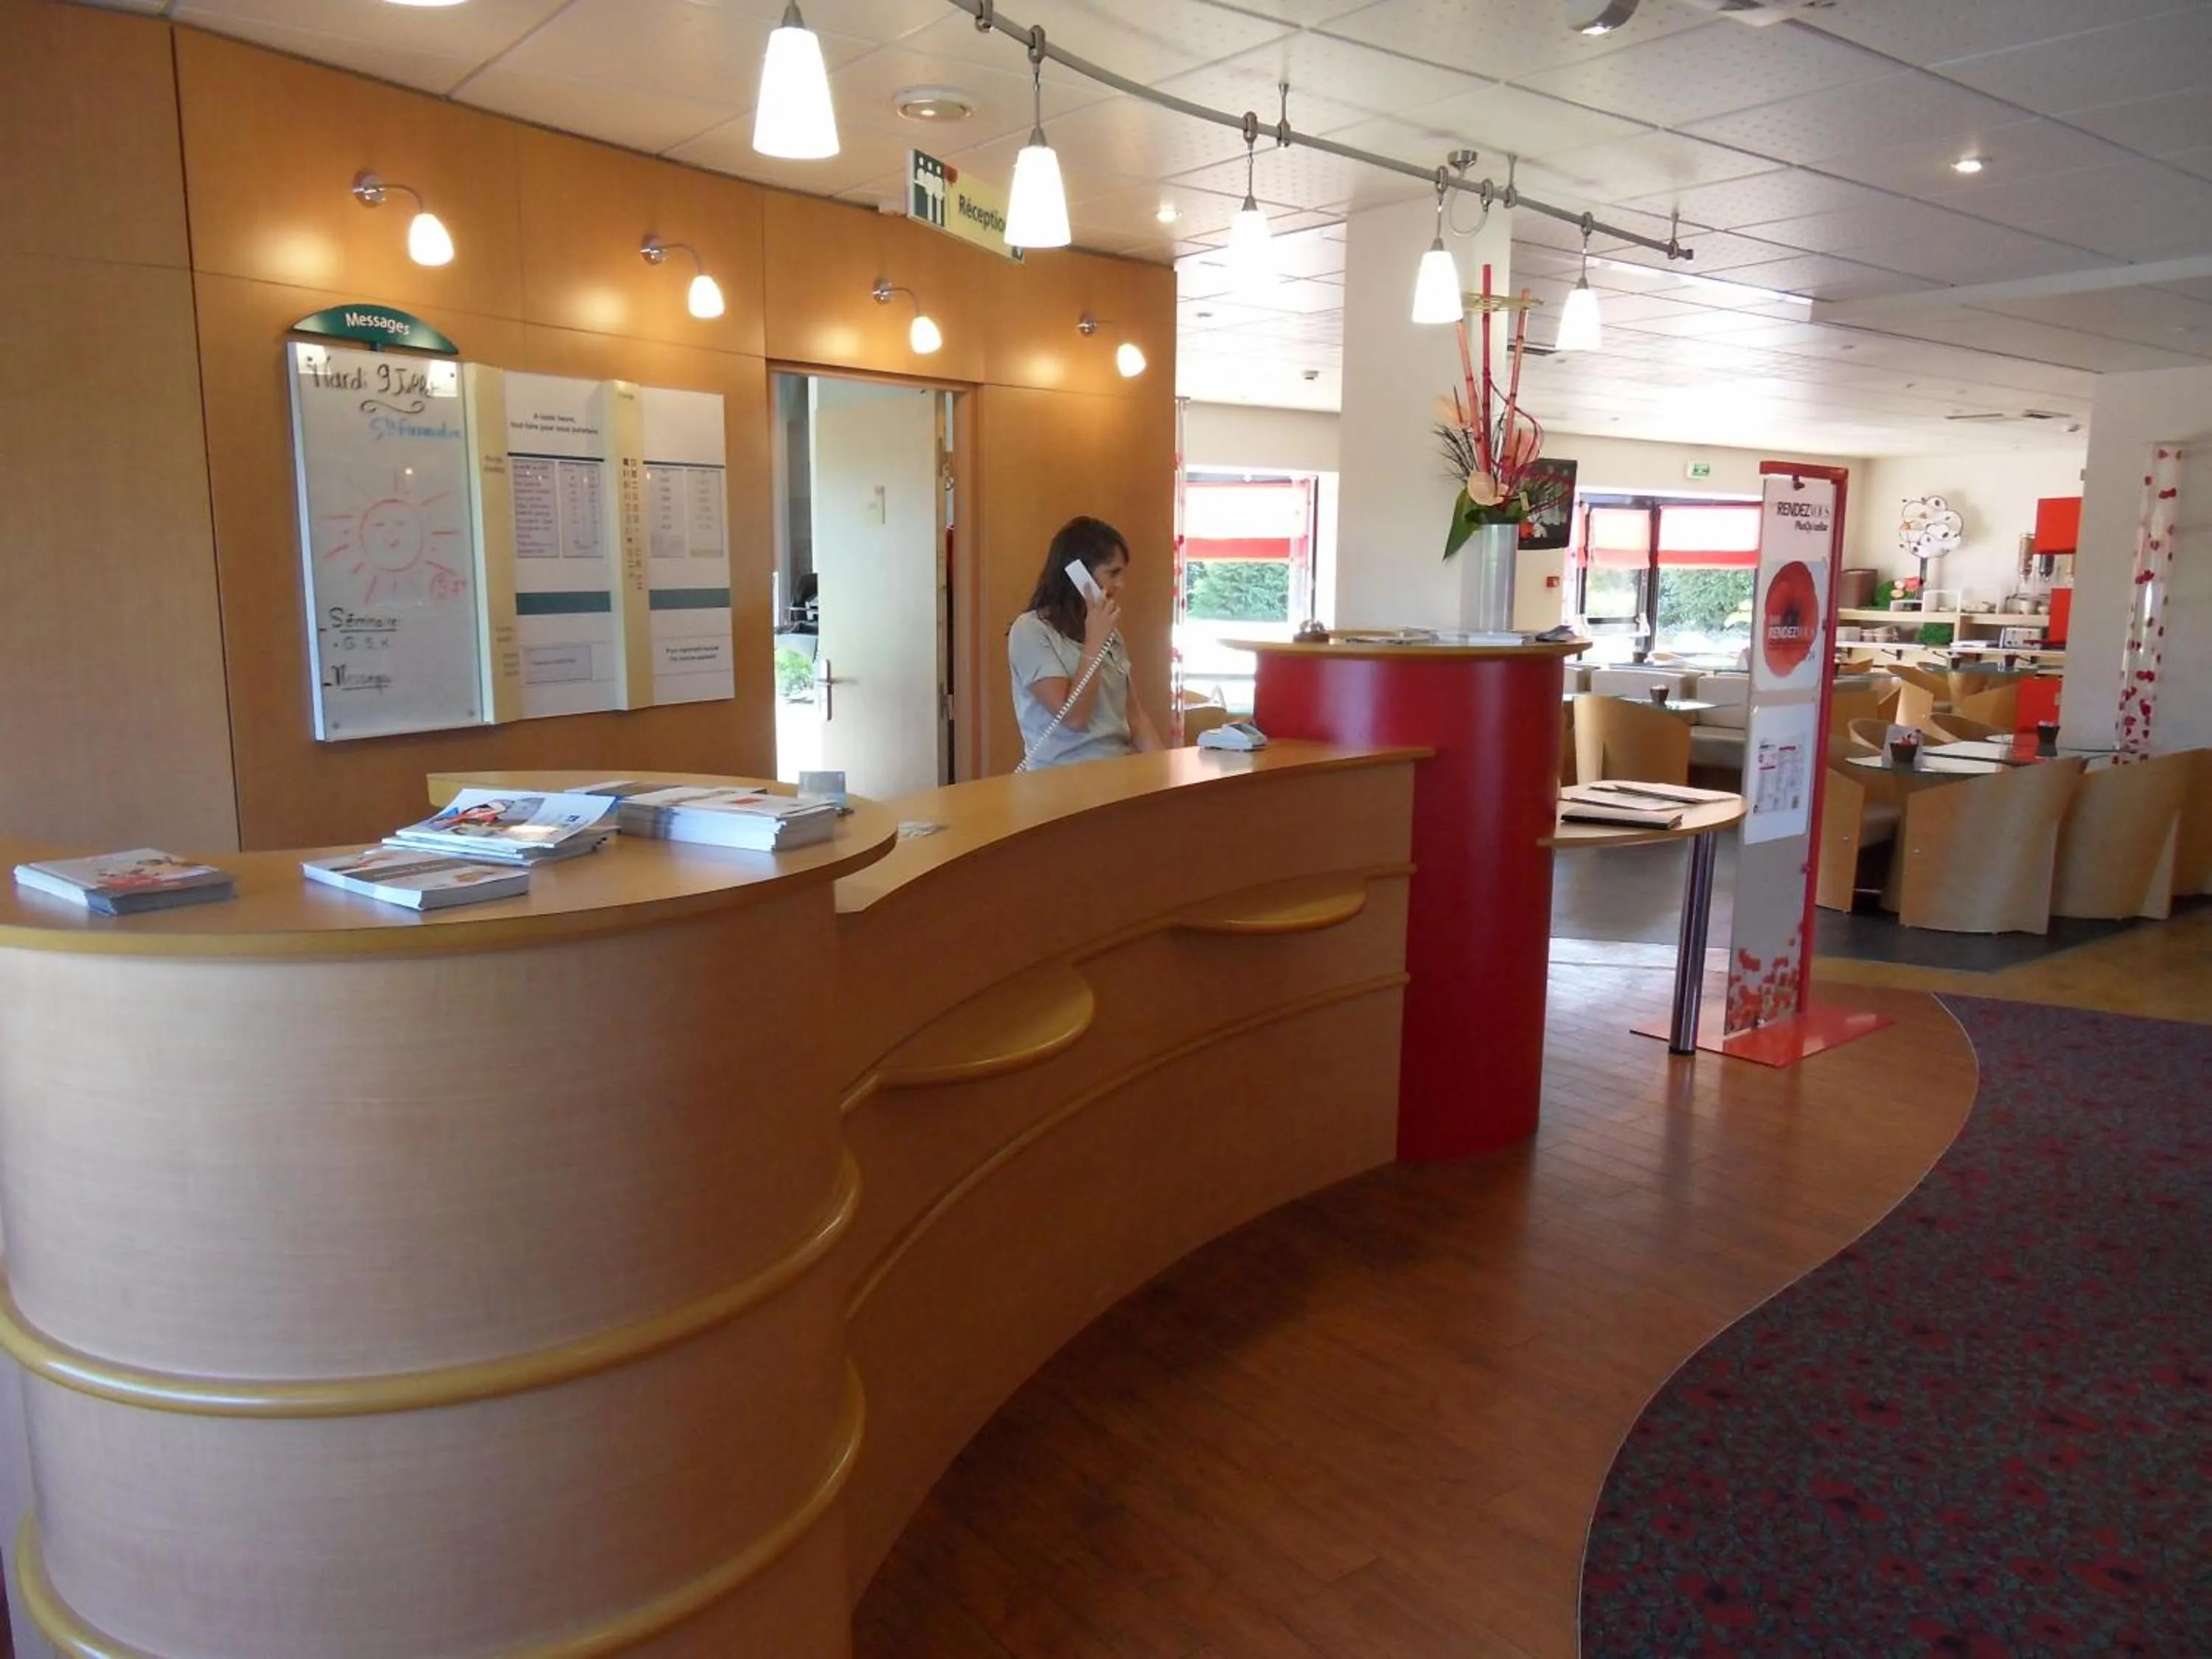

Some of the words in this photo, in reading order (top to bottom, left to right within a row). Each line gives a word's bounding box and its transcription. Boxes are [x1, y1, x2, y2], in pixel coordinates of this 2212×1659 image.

[959, 193, 1006, 232] Réceptio
[345, 313, 410, 335] Messages
[377, 364, 391, 393] 9
